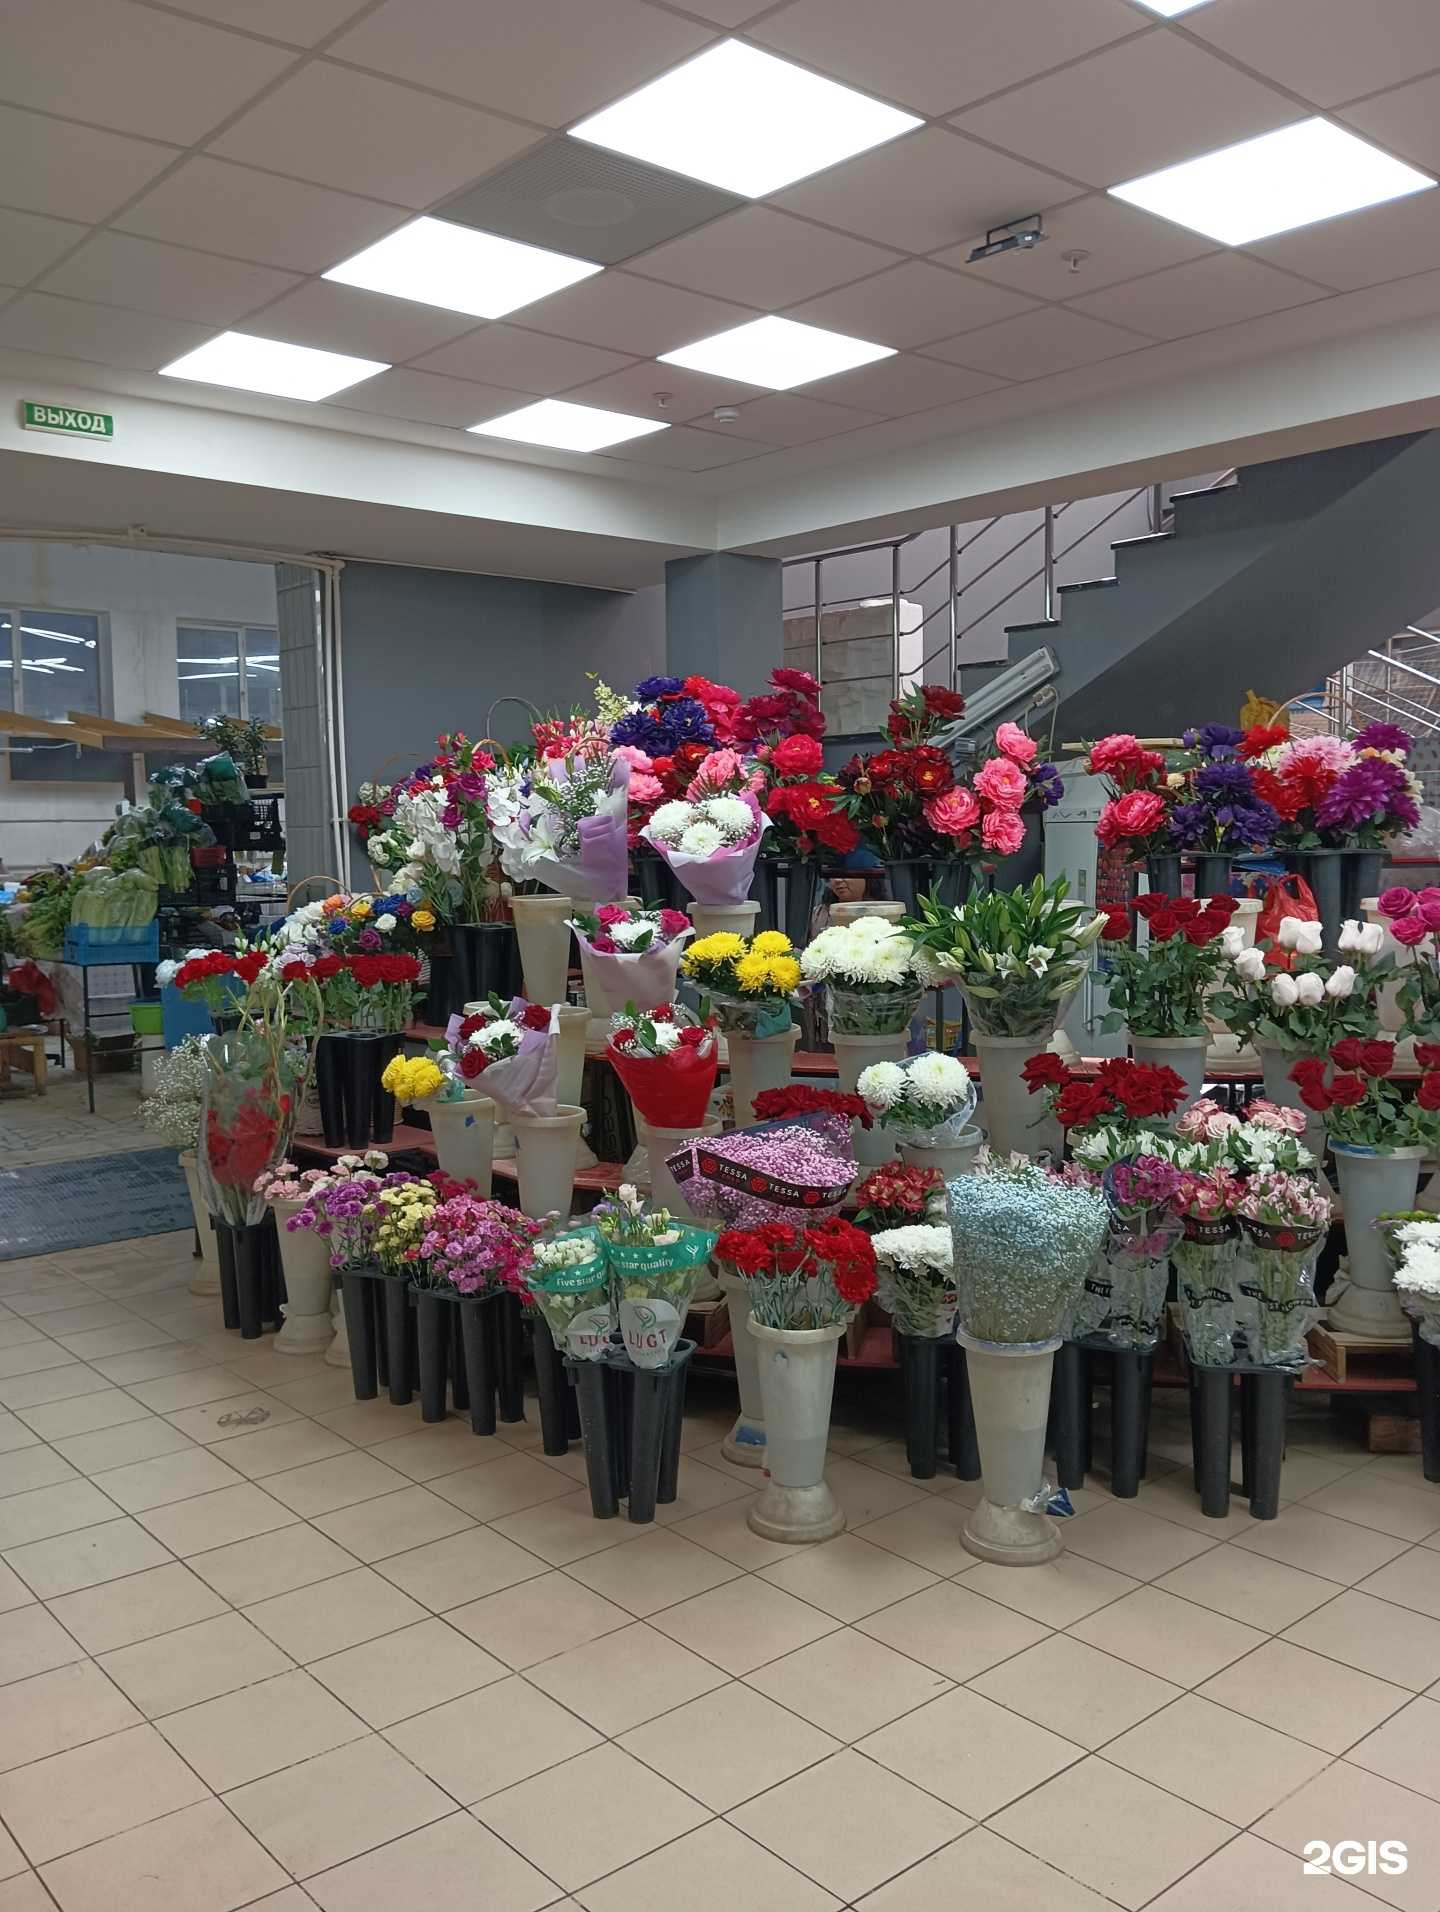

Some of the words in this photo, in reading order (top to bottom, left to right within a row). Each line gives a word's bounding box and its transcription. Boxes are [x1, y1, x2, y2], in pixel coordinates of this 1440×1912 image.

[33, 406, 106, 433] ВЫХОД
[670, 1160, 690, 1172] TESSA
[719, 1164, 748, 1181] TESSA
[769, 1183, 799, 1198] TESSA
[1199, 1224, 1231, 1234] TESSA
[640, 1257, 674, 1272] quality
